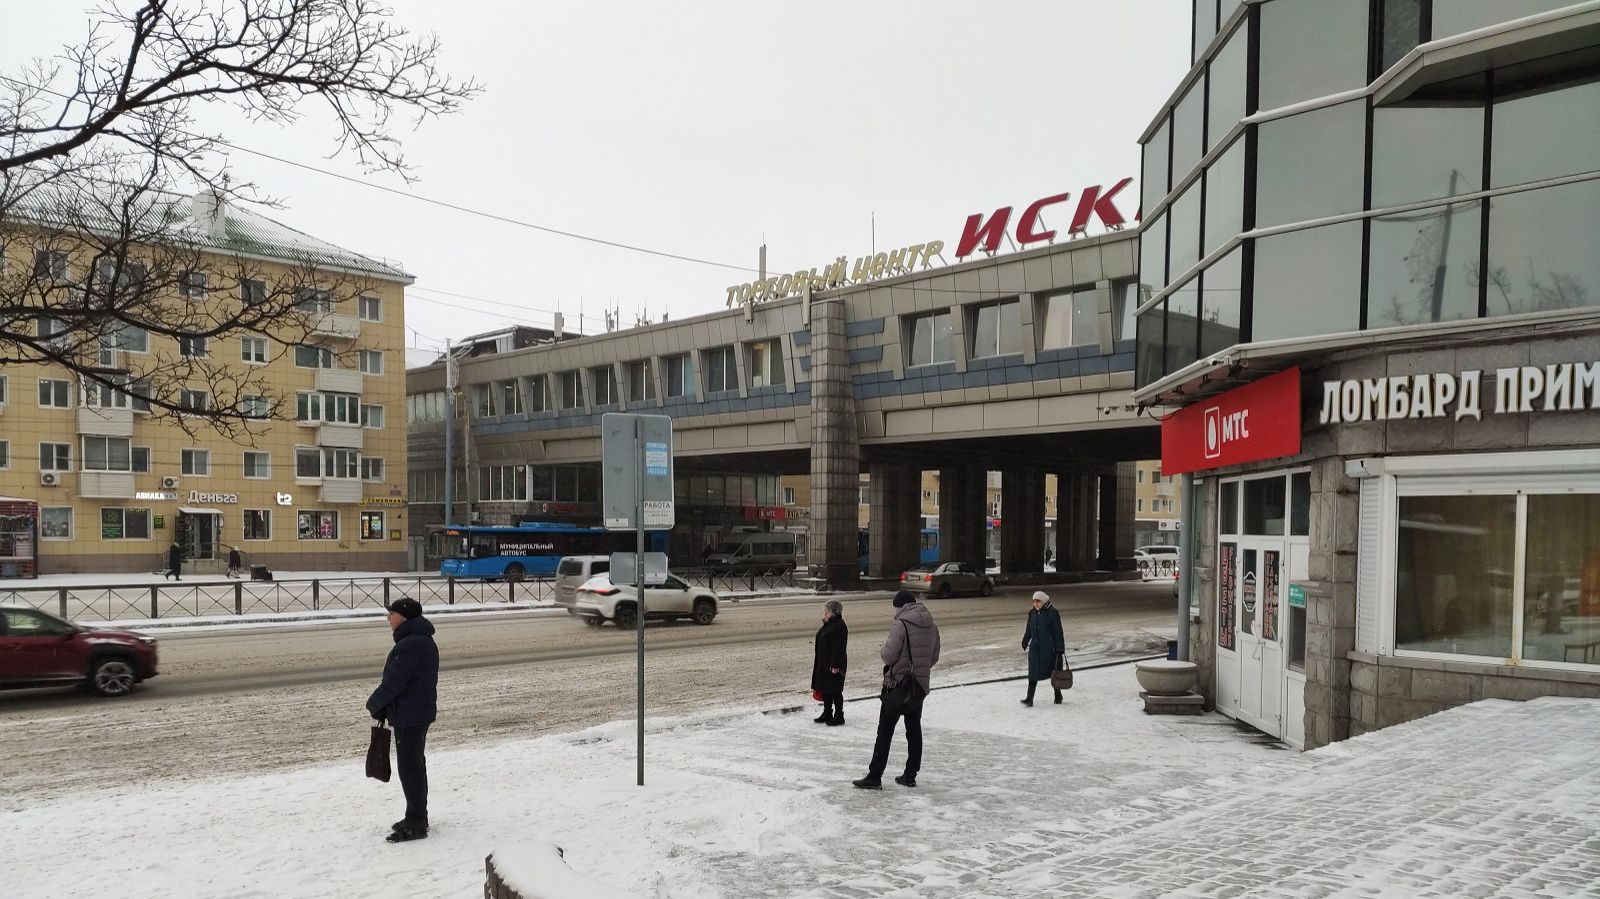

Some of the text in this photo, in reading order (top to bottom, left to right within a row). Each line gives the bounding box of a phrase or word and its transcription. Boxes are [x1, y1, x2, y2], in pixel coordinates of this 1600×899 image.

[955, 177, 1140, 257] ИСК
[726, 256, 848, 307] ТОРГОВЫЙ
[1320, 370, 1482, 424] ЛОМБАРД
[1222, 409, 1249, 443] МТС
[499, 542, 554, 550] МУНИЦИПАЛЬНЫЙ
